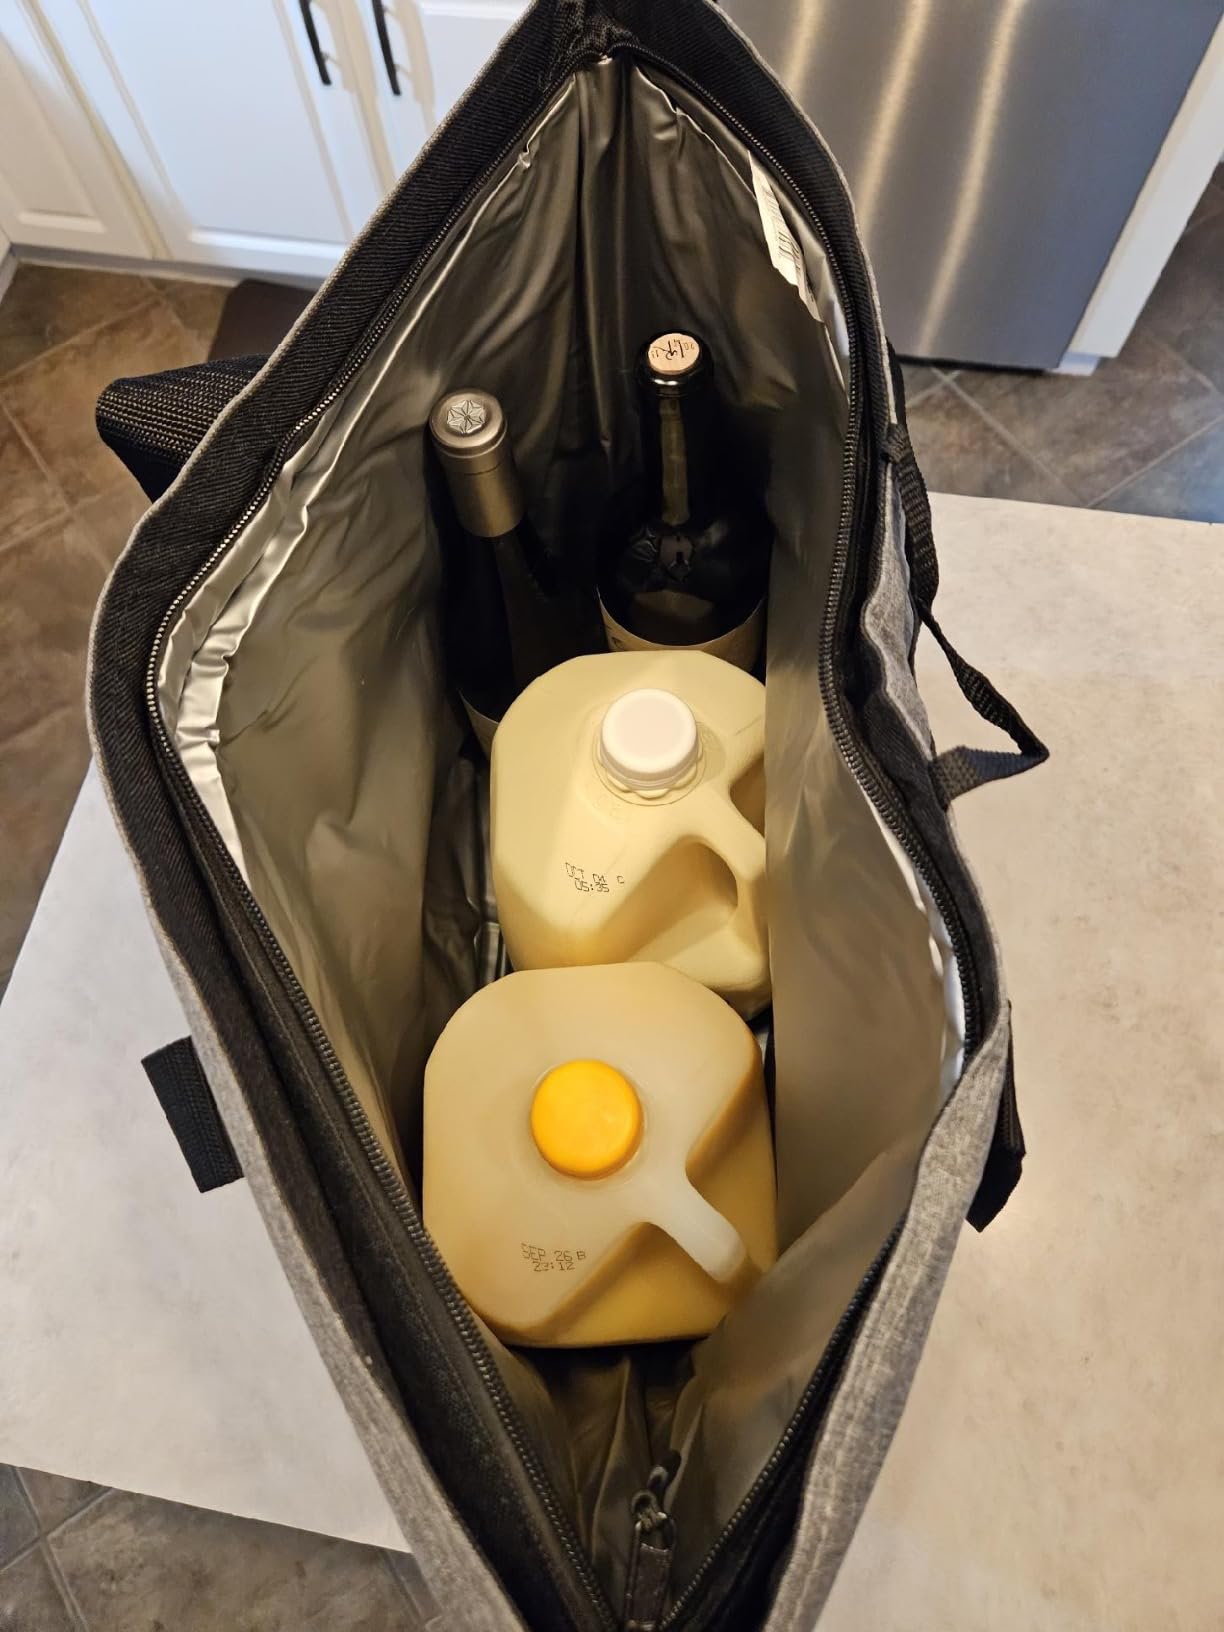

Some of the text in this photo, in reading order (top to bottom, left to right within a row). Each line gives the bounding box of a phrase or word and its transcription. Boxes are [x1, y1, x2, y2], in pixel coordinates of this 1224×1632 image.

[574, 877, 610, 893] 05:35
[521, 1242, 586, 1262] SEP 26 B
